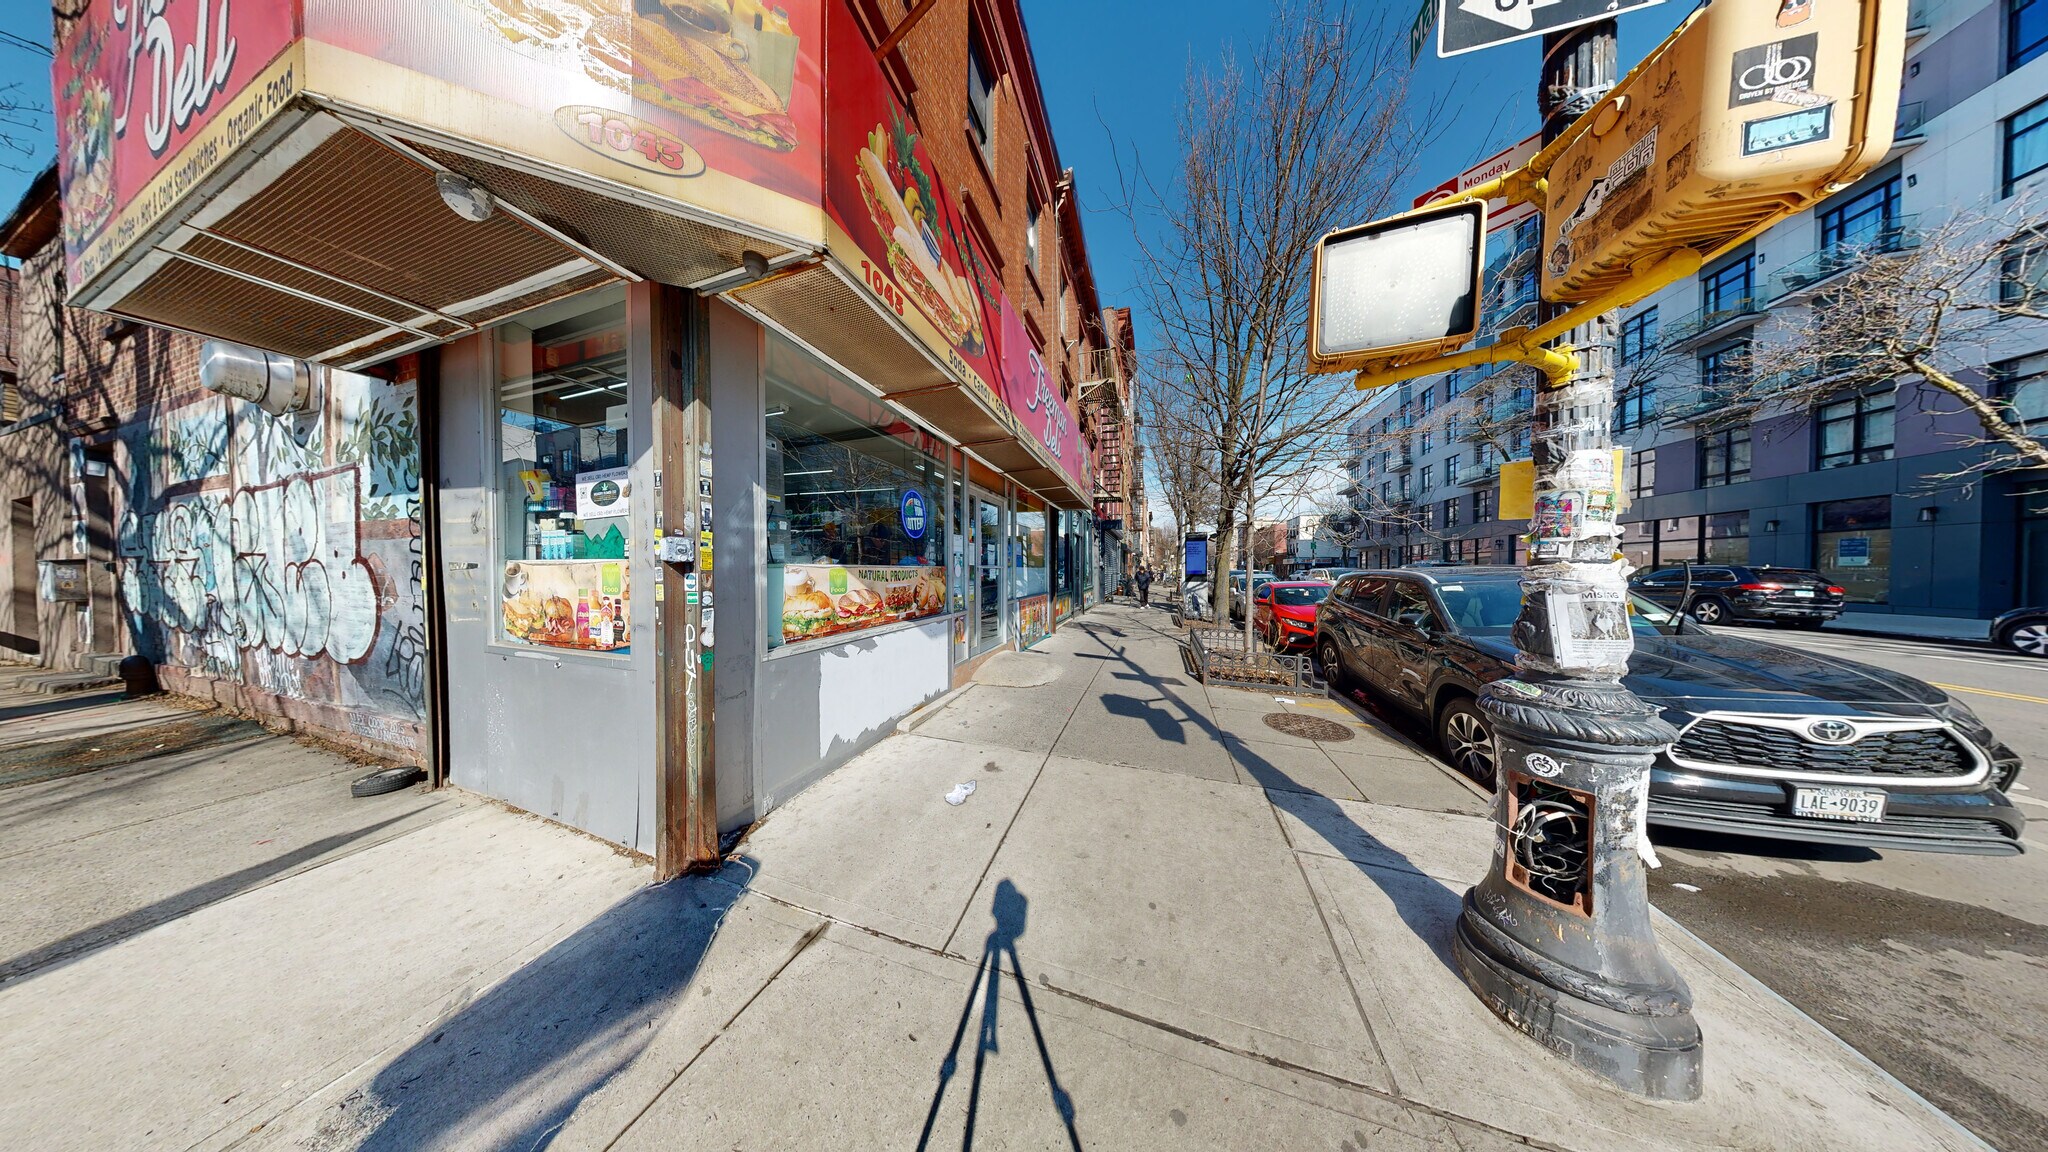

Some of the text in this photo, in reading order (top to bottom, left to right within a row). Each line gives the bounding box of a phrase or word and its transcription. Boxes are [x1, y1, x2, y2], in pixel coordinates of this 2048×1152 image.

[1739, 90, 1763, 100] DRIVEN
[174, 136, 218, 197] Sandwiches
[226, 93, 263, 148] Organic
[266, 62, 293, 114] Food
[577, 112, 685, 171] 1043
[1463, 159, 1511, 190] Monday
[861, 260, 904, 316] 1043
[949, 349, 967, 377] Soda
[973, 375, 990, 403] Candy
[1026, 349, 1068, 437] Freeman
[1043, 409, 1061, 459] Deli
[858, 570, 889, 582] NATURAL
[890, 570, 919, 582] PRODUCTS
[1843, 815, 1883, 823] TOYOTA
